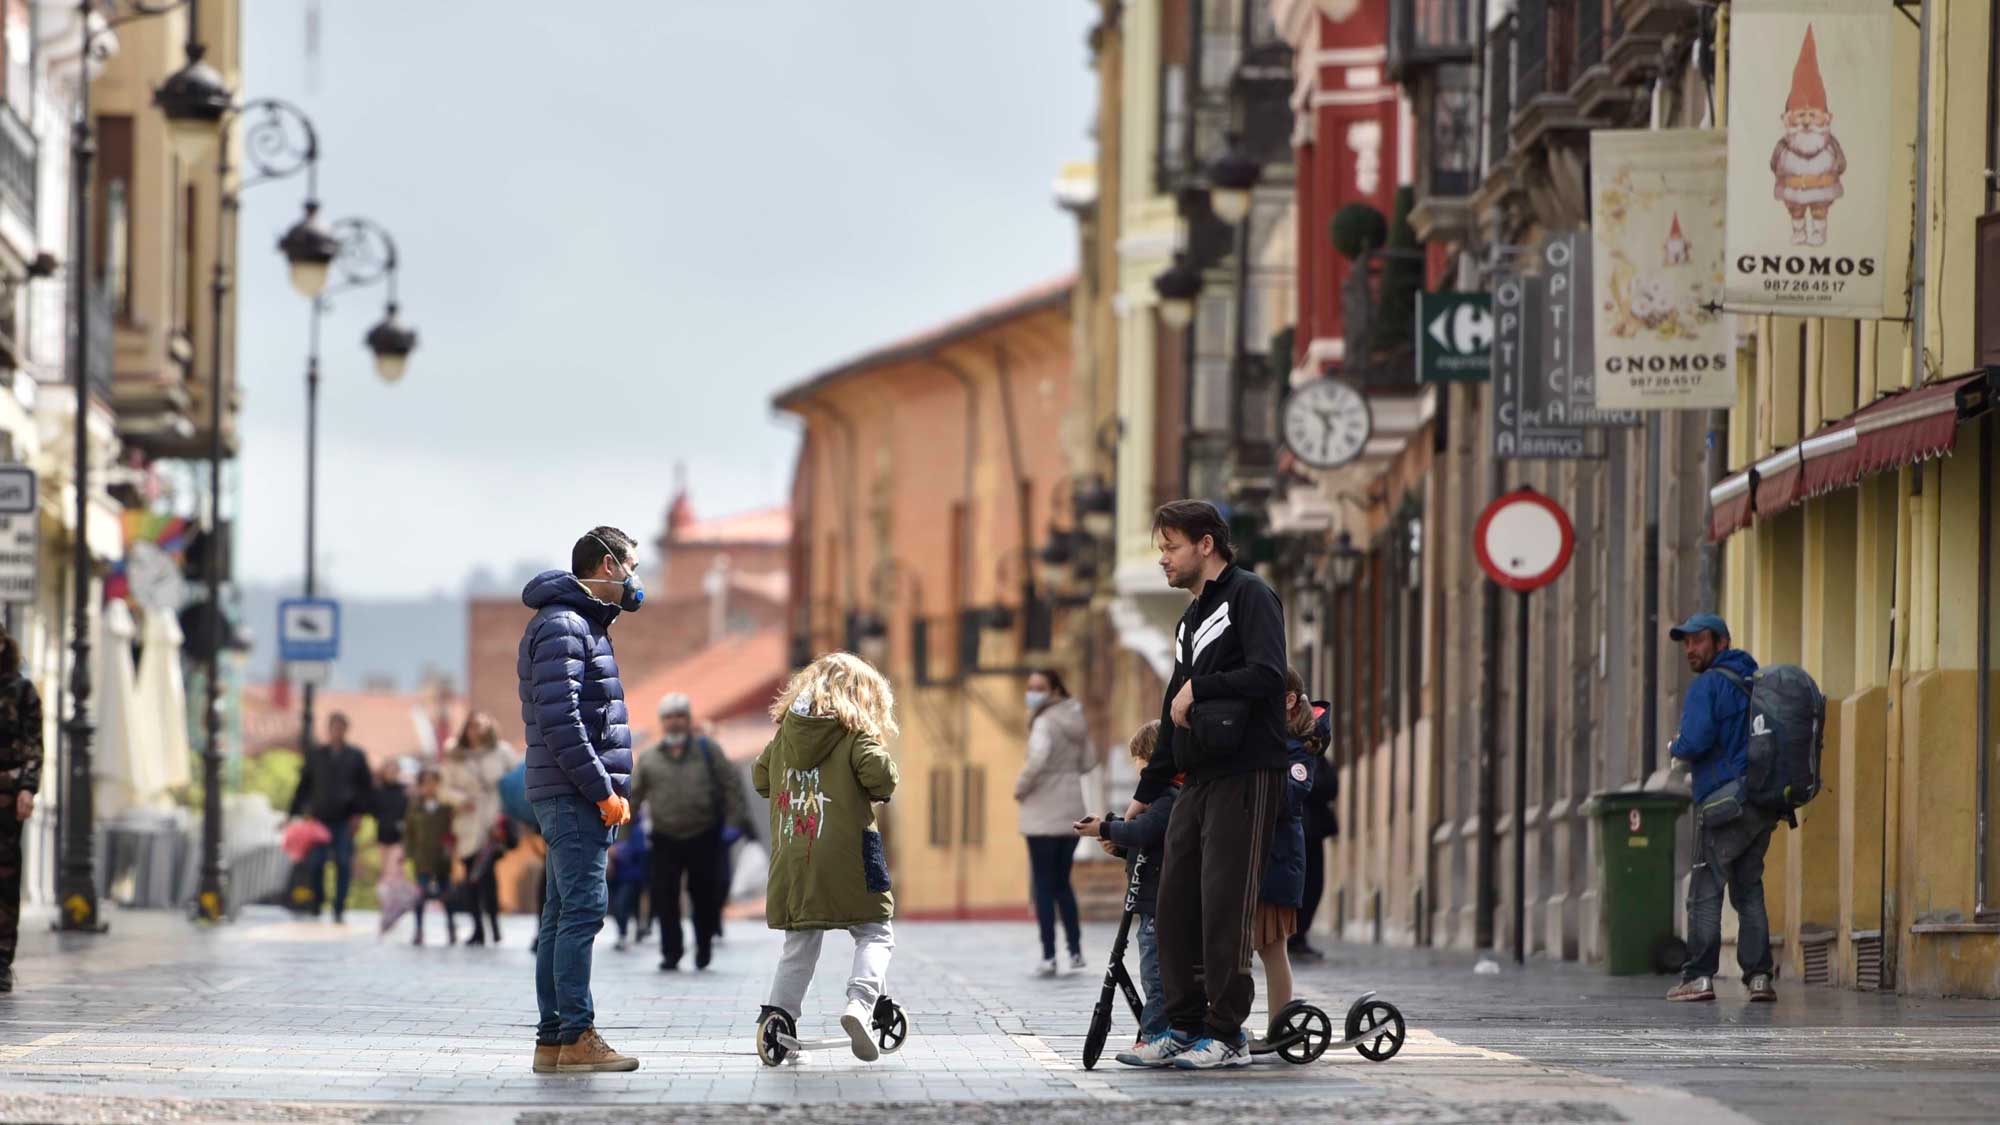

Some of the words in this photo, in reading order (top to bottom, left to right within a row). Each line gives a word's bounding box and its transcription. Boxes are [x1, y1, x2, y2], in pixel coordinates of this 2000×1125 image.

[1737, 255, 1875, 277] GNOMOS
[1546, 241, 1570, 422] OPTICA
[1498, 282, 1520, 454] OPTICA
[1605, 354, 1727, 374] GNOMOS
[1629, 808, 1641, 831] 9
